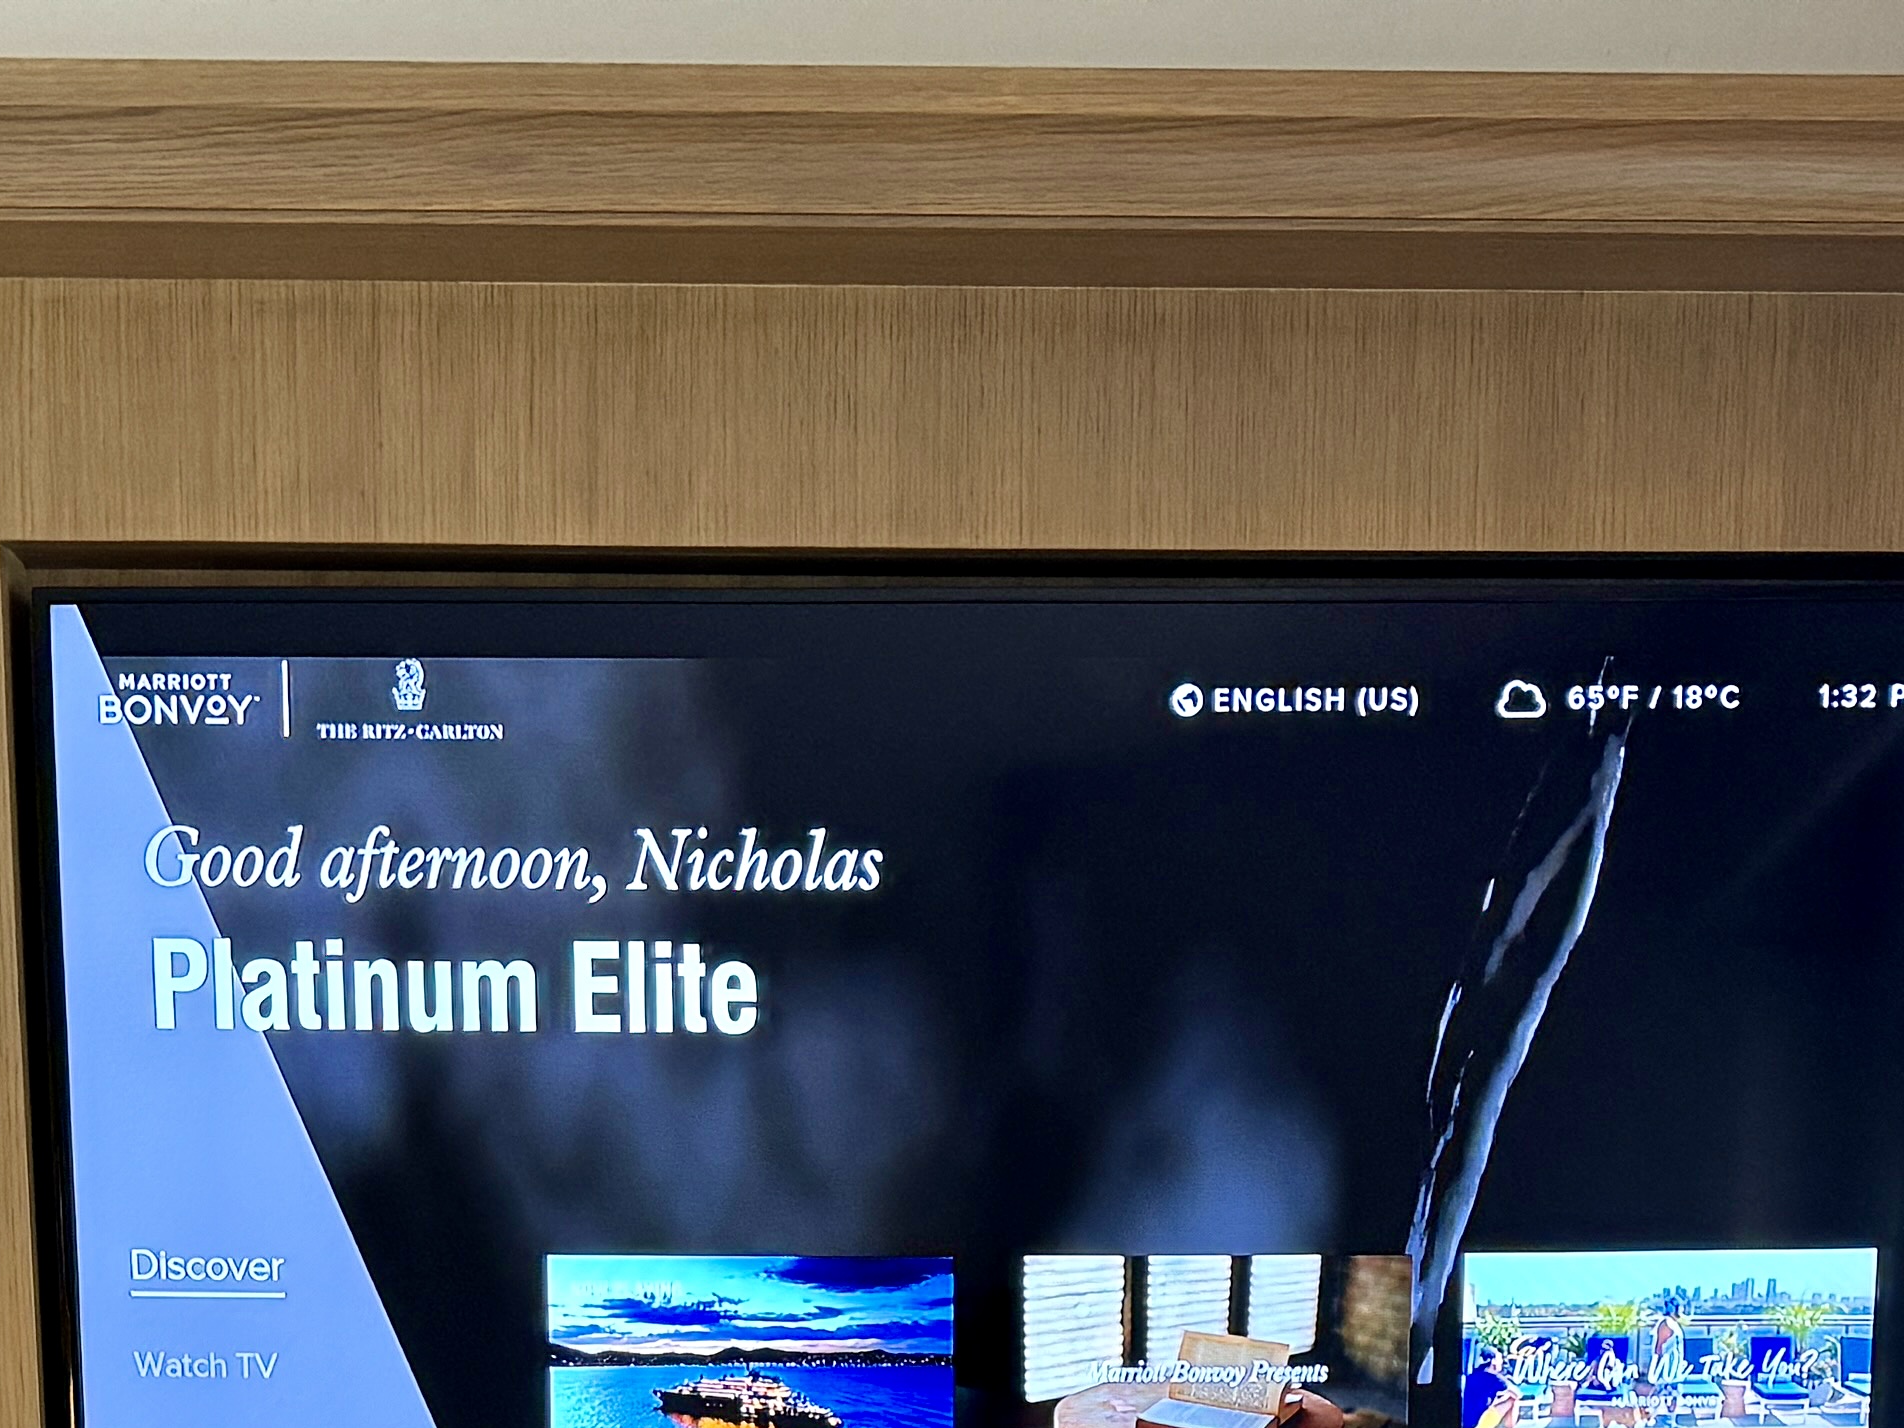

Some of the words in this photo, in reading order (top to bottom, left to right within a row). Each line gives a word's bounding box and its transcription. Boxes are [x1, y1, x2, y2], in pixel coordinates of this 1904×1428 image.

[118, 673, 232, 692] MARRIOTT
[1648, 686, 1662, 711] /
[1673, 684, 1741, 710] 18°C
[1818, 684, 1877, 710] 1:32
[98, 694, 256, 726] BONVOY
[1212, 686, 1346, 714] ENGLISH
[1357, 685, 1420, 717] (US)
[316, 722, 357, 740] THE
[144, 825, 302, 889] Good
[319, 825, 609, 904] afternoon,
[626, 827, 885, 892] Nicholas
[151, 937, 538, 1034] Platinum
[571, 939, 760, 1036] Elite
[129, 1248, 286, 1283] Discover
[133, 1350, 228, 1379] Watch
[235, 1352, 279, 1380] TV
[1172, 1360, 1246, 1387] Bonvoy
[1251, 1359, 1330, 1385] Presents
